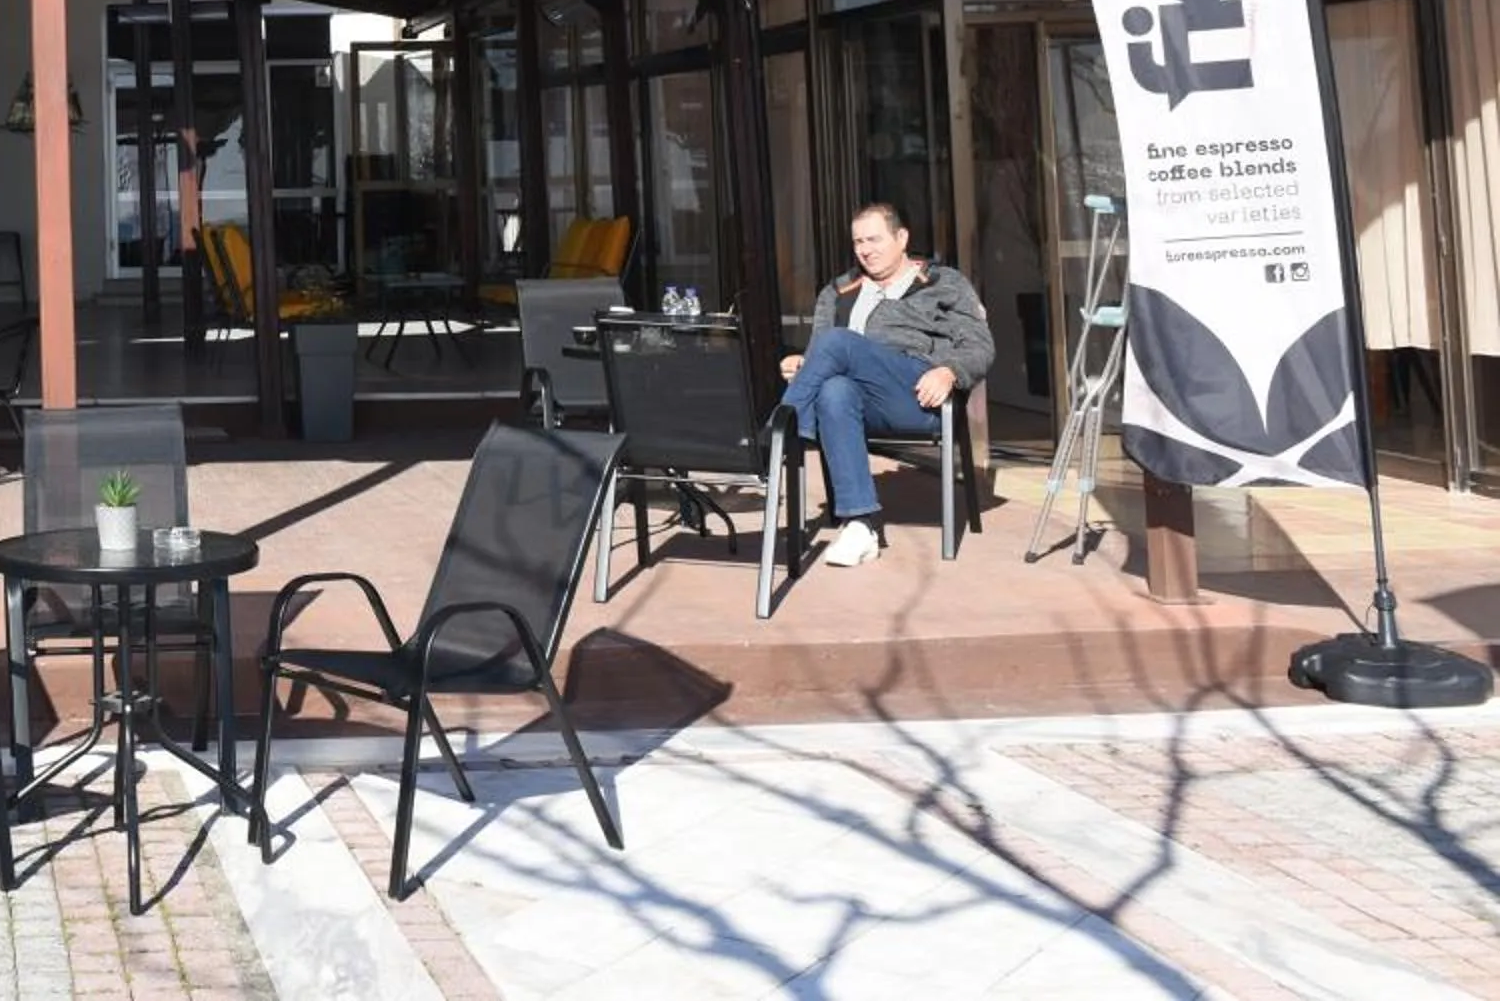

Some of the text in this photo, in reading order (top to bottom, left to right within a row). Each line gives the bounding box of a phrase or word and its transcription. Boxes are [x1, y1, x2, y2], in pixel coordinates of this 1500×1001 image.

[1147, 138, 1293, 159] fine espresso
[1148, 159, 1298, 182] coffee blends
[1157, 181, 1300, 206] from selected
[1207, 204, 1302, 224] varieties
